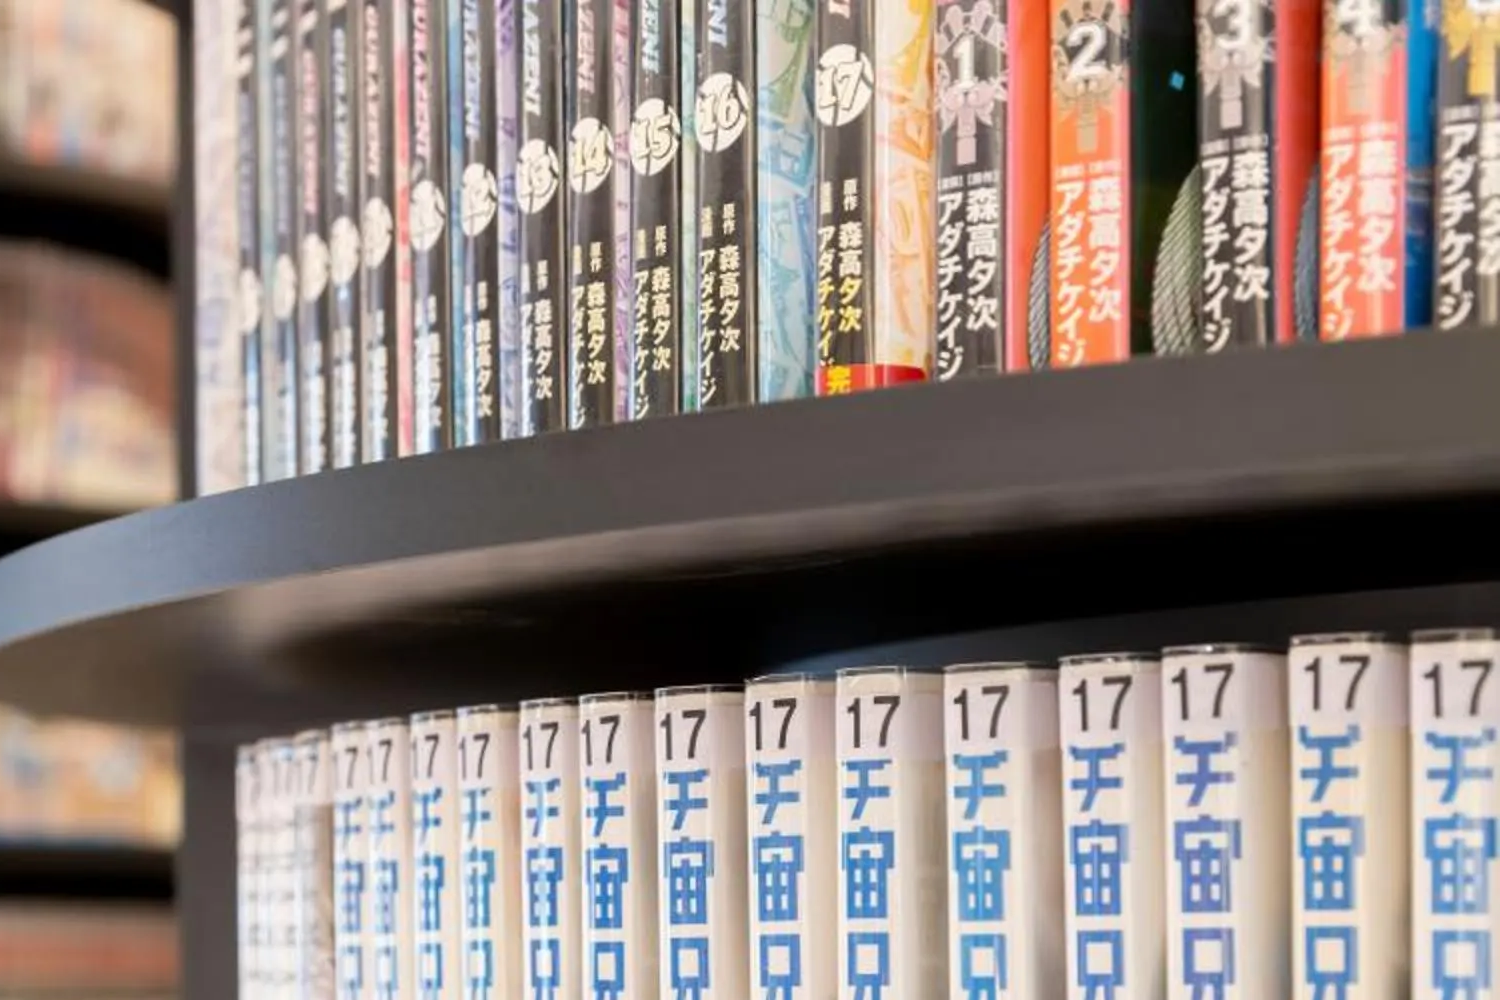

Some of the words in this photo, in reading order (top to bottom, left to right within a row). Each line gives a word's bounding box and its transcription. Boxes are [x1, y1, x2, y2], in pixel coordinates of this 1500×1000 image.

[952, 34, 975, 89] 1
[1065, 22, 1110, 83] 2
[1437, 123, 1478, 330] アダチケイジ
[966, 187, 999, 332] 森高夕次
[1201, 156, 1232, 355] アダチケイジ
[817, 225, 836, 366] アダチケイ
[937, 191, 964, 383] アダチケイジ
[1072, 675, 1133, 732] 17
[1171, 663, 1235, 721] 17
[1304, 655, 1371, 711] 17
[1422, 660, 1494, 718] 17
[581, 714, 621, 767] 17
[659, 709, 707, 761] 17
[749, 698, 797, 751] 17
[847, 695, 900, 748] 17
[953, 684, 1010, 741] 17
[459, 732, 490, 781] 17
[522, 722, 559, 771] 17
